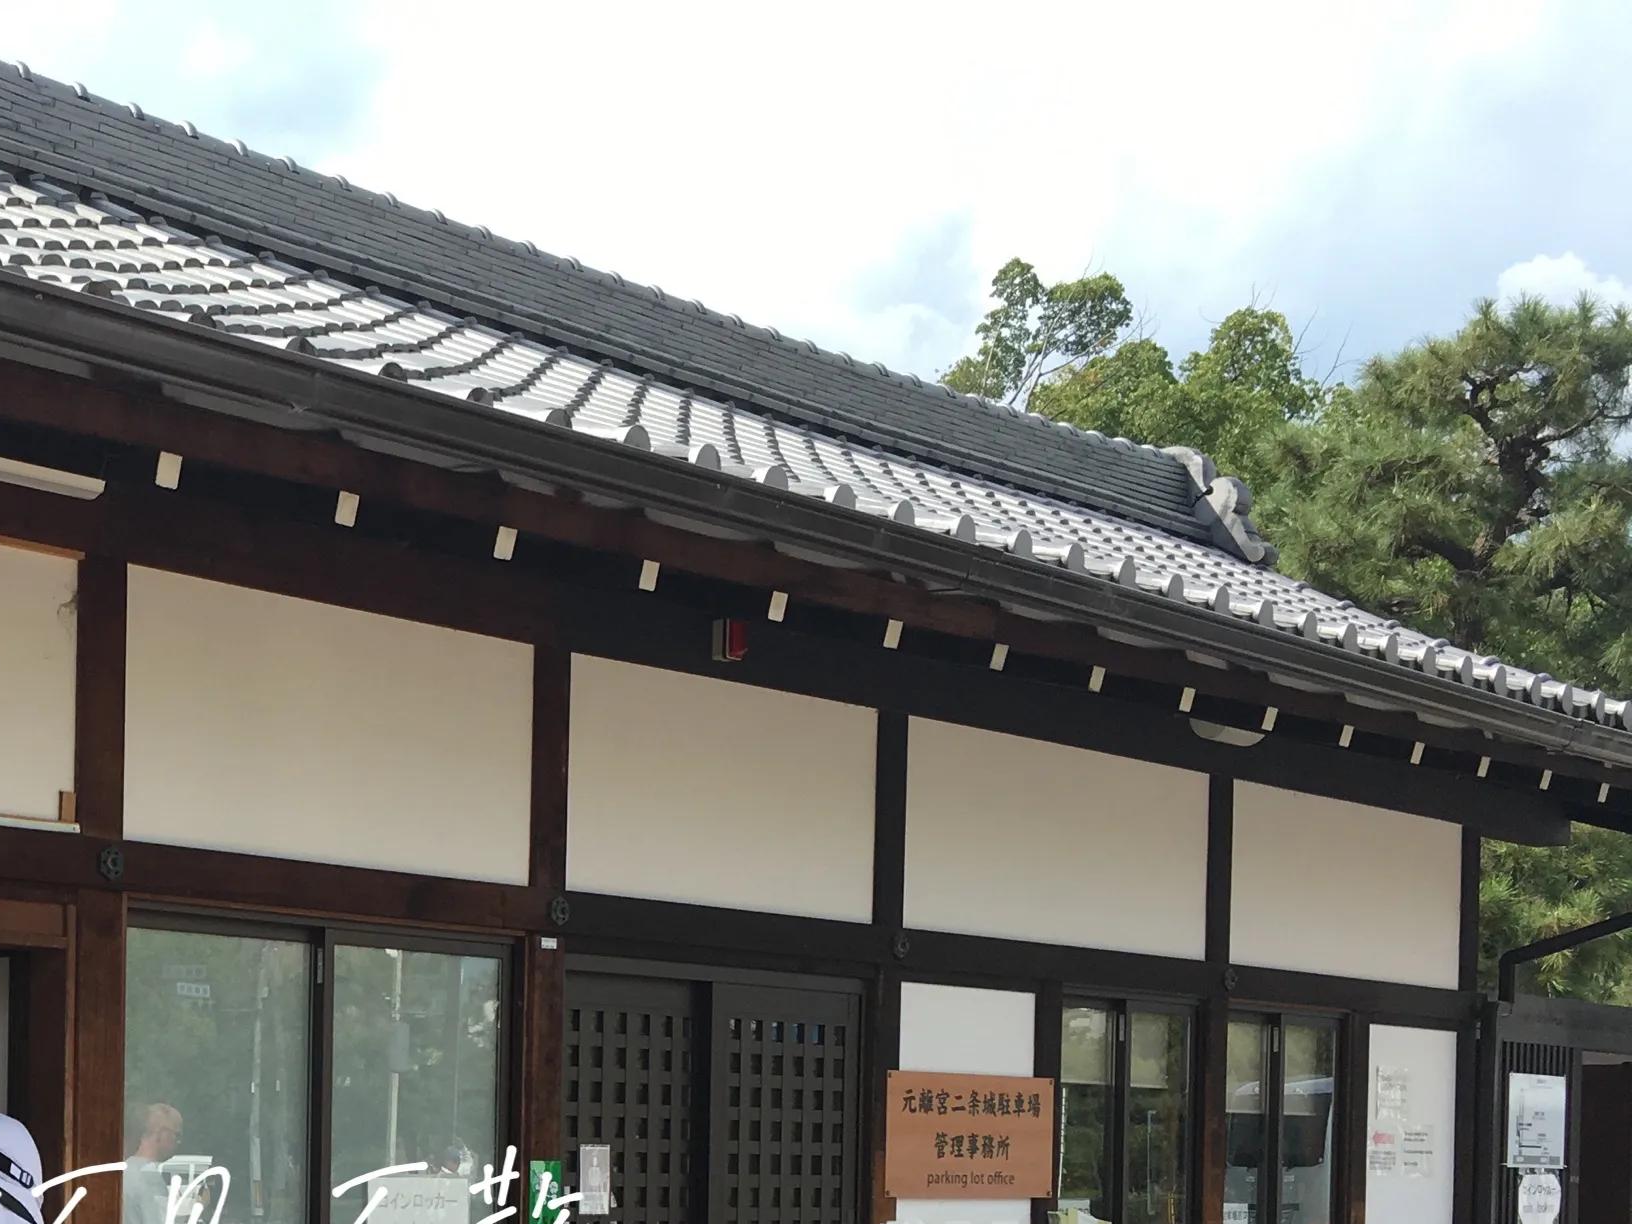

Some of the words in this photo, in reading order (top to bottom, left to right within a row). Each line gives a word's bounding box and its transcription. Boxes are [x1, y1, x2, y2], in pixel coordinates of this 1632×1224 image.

[901, 1087, 1041, 1119] 元離宮二条城駐車場
[934, 1131, 1011, 1161] 管理事務所
[926, 1170, 968, 1188] parking
[970, 1171, 985, 1185] lot
[987, 1171, 1016, 1185] office
